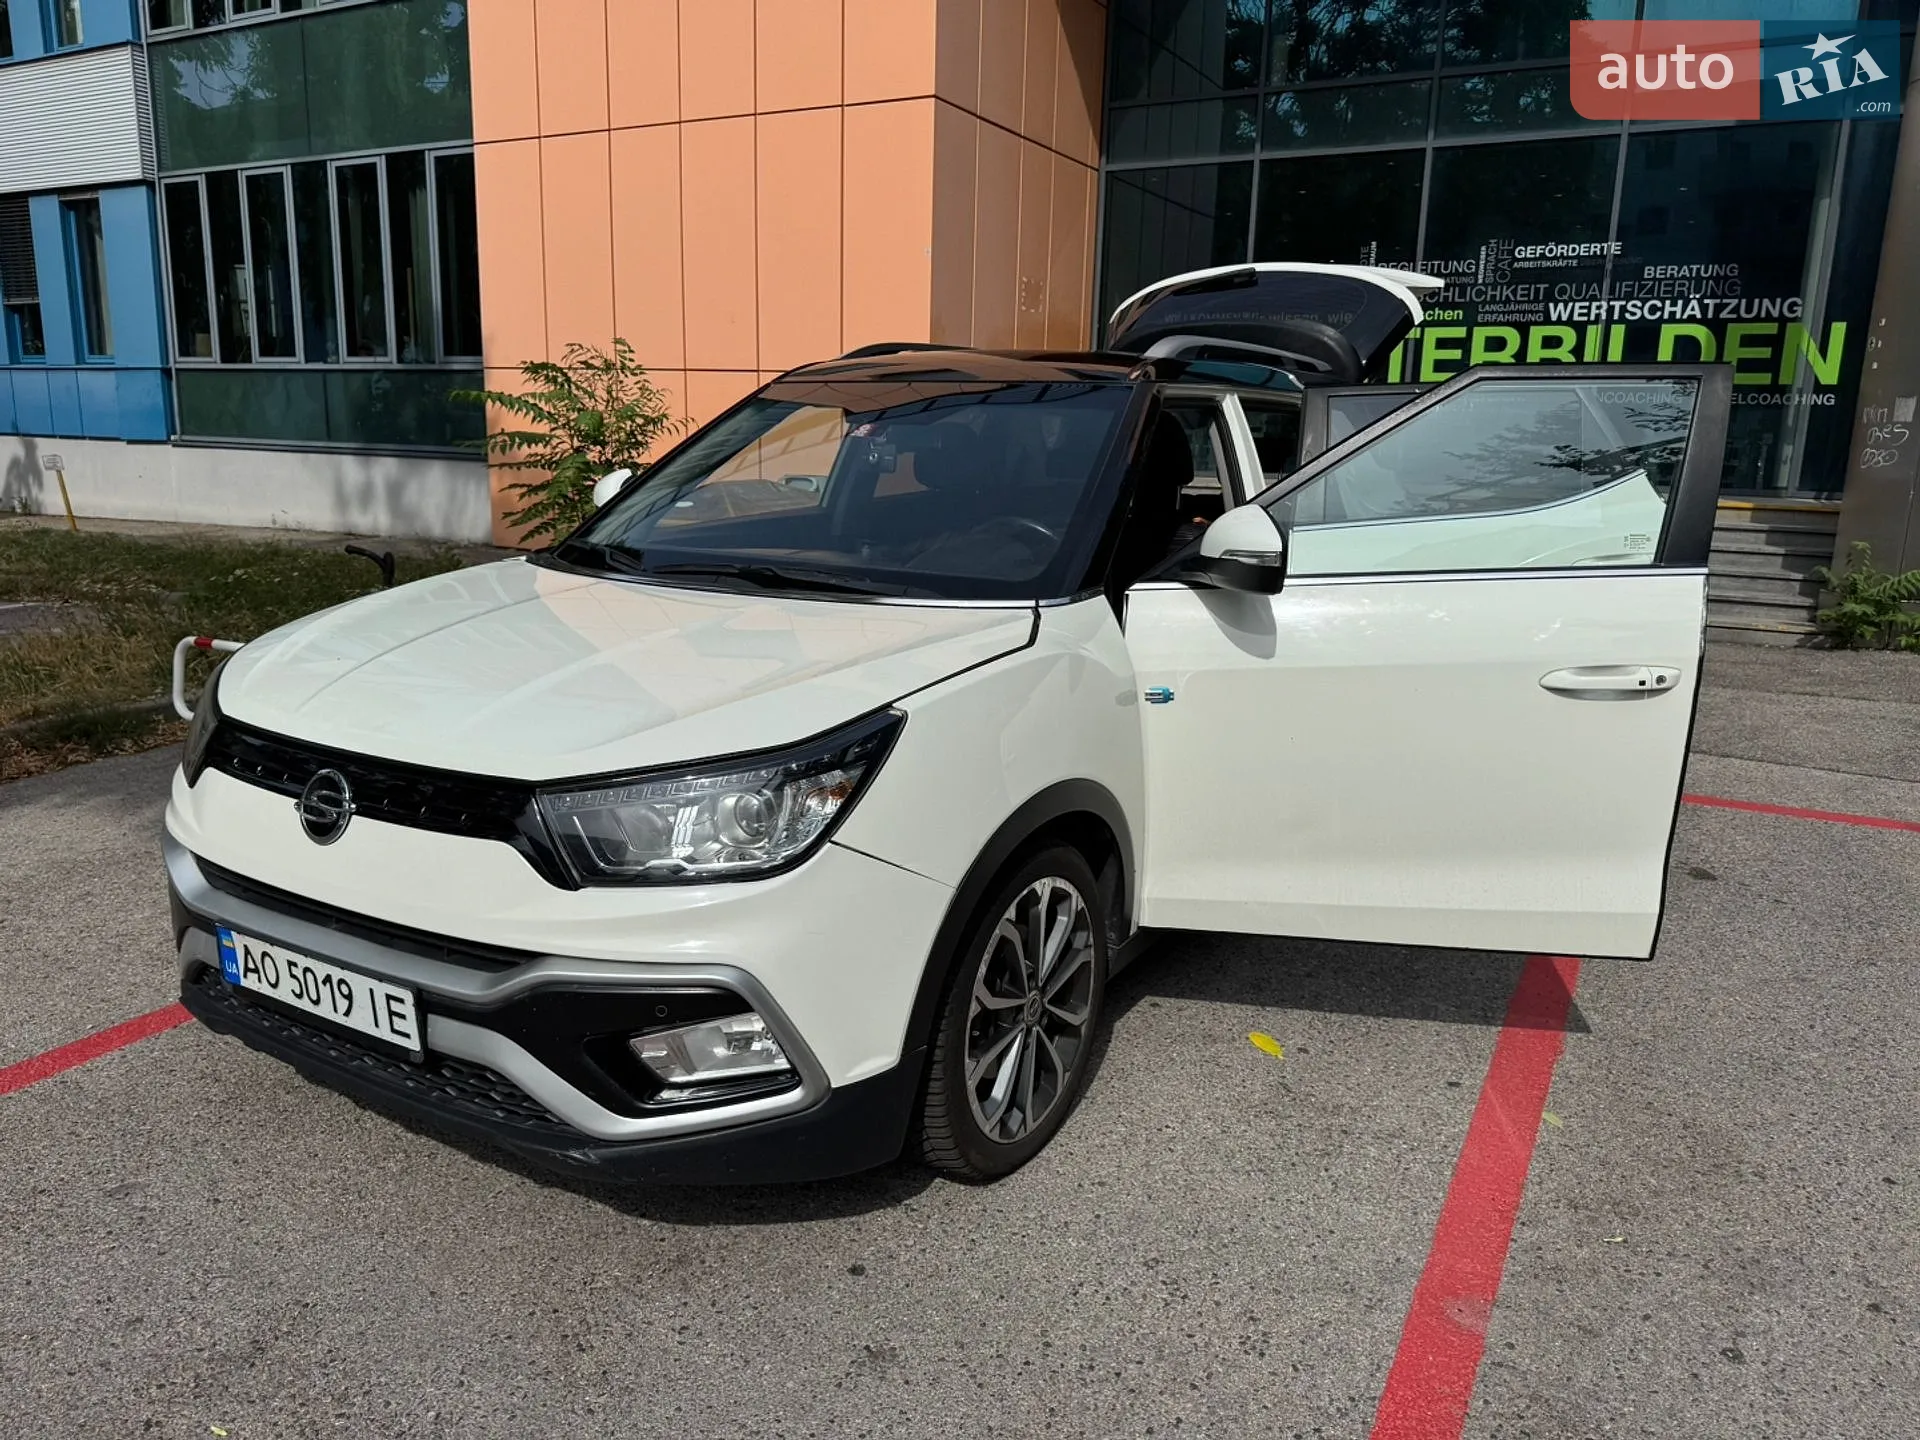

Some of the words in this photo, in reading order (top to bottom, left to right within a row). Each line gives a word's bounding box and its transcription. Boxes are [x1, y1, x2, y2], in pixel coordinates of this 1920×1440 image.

[1514, 242, 1622, 259] GEFÖRDERTE
[1512, 258, 1579, 269] ARBEITSKRÄFTE
[1643, 263, 1739, 279] BERATUNG
[1418, 283, 1550, 303] CHLICHKEIT
[1554, 278, 1742, 301] QUALIFIZIERUNG
[1478, 301, 1545, 313] LANGJÄHRIGE
[1548, 293, 1803, 322] WERTSCHÄTZUNG
[1477, 311, 1545, 323] ERFAHRUNG
[225, 962, 239, 976] UA
[242, 943, 281, 989] AO
[286, 958, 354, 1017] 5019
[369, 987, 412, 1040] IE
